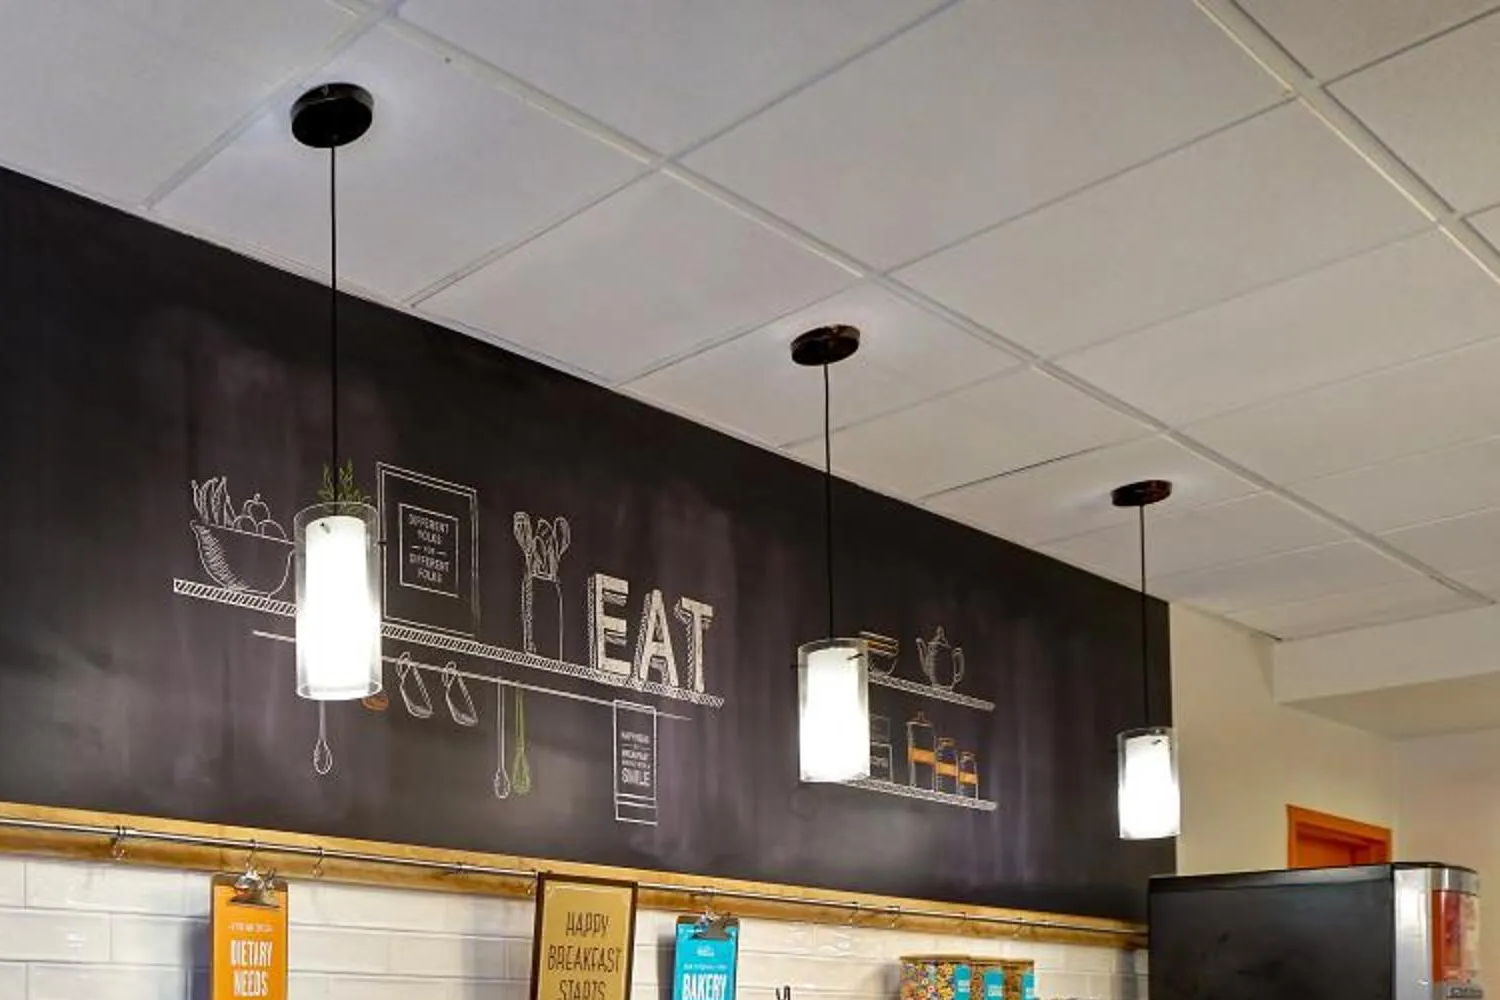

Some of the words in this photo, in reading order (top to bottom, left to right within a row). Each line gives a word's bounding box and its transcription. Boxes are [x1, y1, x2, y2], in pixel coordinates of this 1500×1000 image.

[408, 552, 450, 573] DIFFERENT
[588, 573, 714, 694] EAT
[565, 911, 609, 938] HAPPY
[231, 940, 273, 967] DIETARY
[548, 945, 622, 973] BREAKFAST
[233, 970, 269, 997] NEEDS
